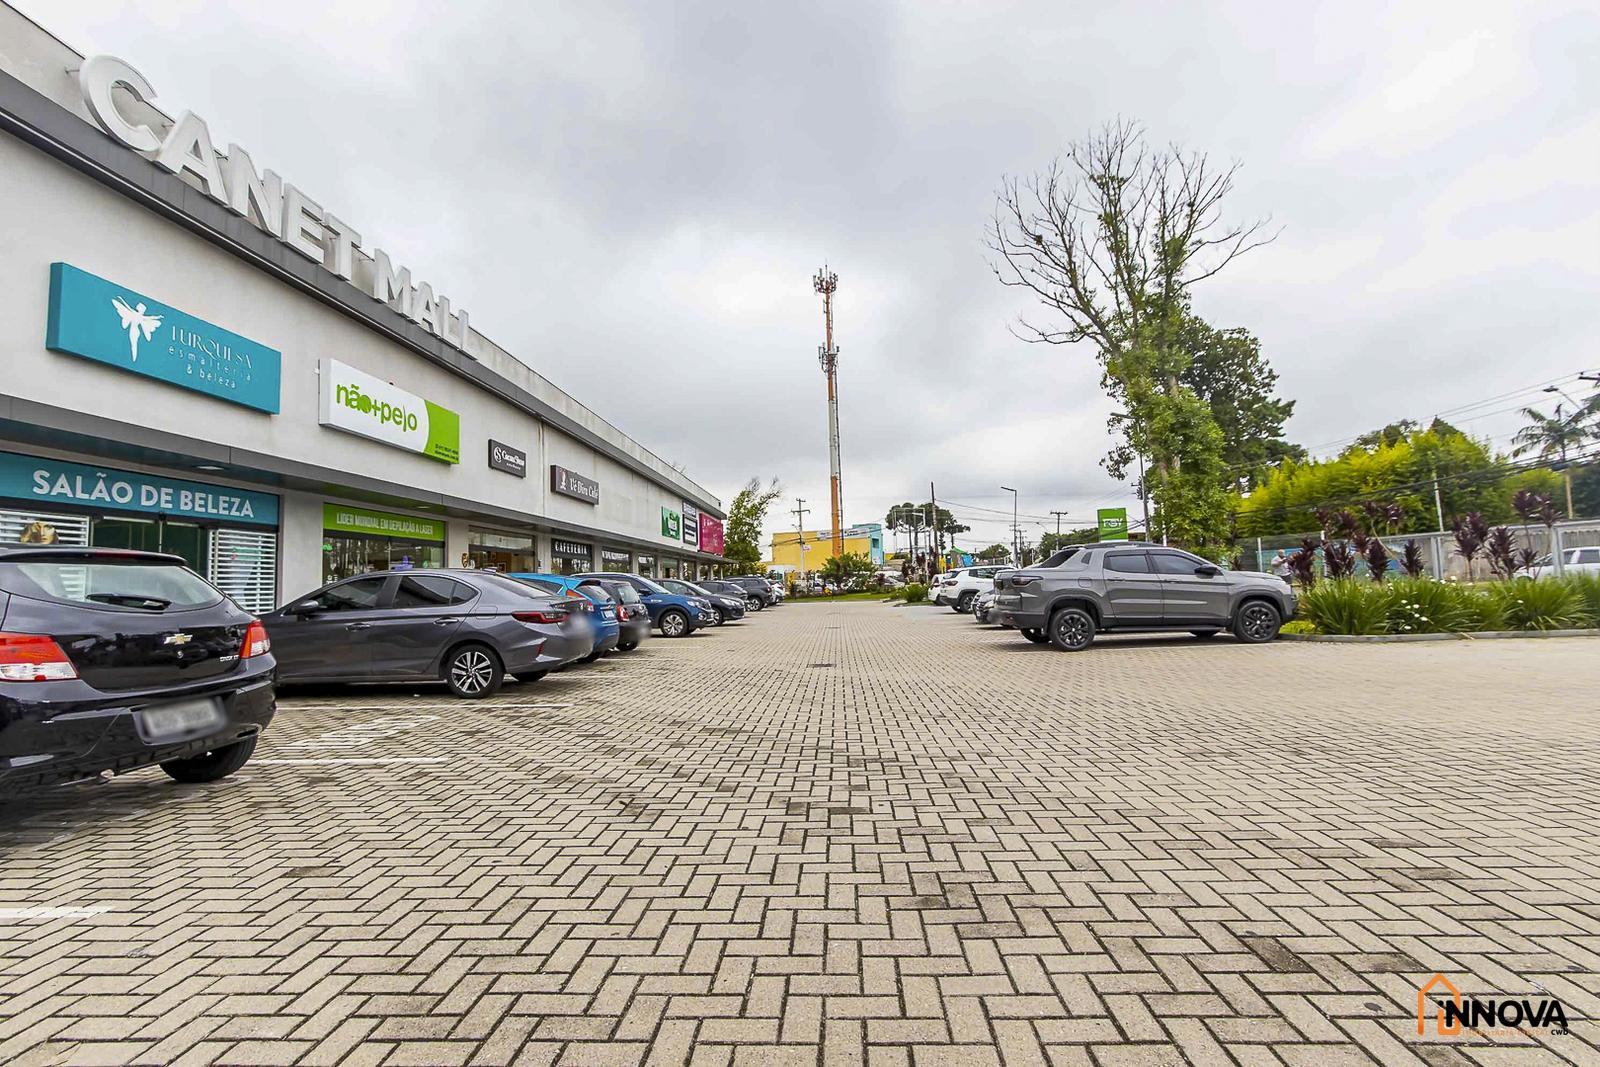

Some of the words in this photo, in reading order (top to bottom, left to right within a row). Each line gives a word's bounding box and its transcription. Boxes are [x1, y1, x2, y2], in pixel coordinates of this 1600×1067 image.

[79, 54, 362, 282] CANET
[373, 248, 470, 353] MALL
[199, 368, 236, 389] beleza
[32, 469, 134, 504] SALÃO
[140, 484, 175, 510] DE
[179, 490, 254, 518] BELEZA
